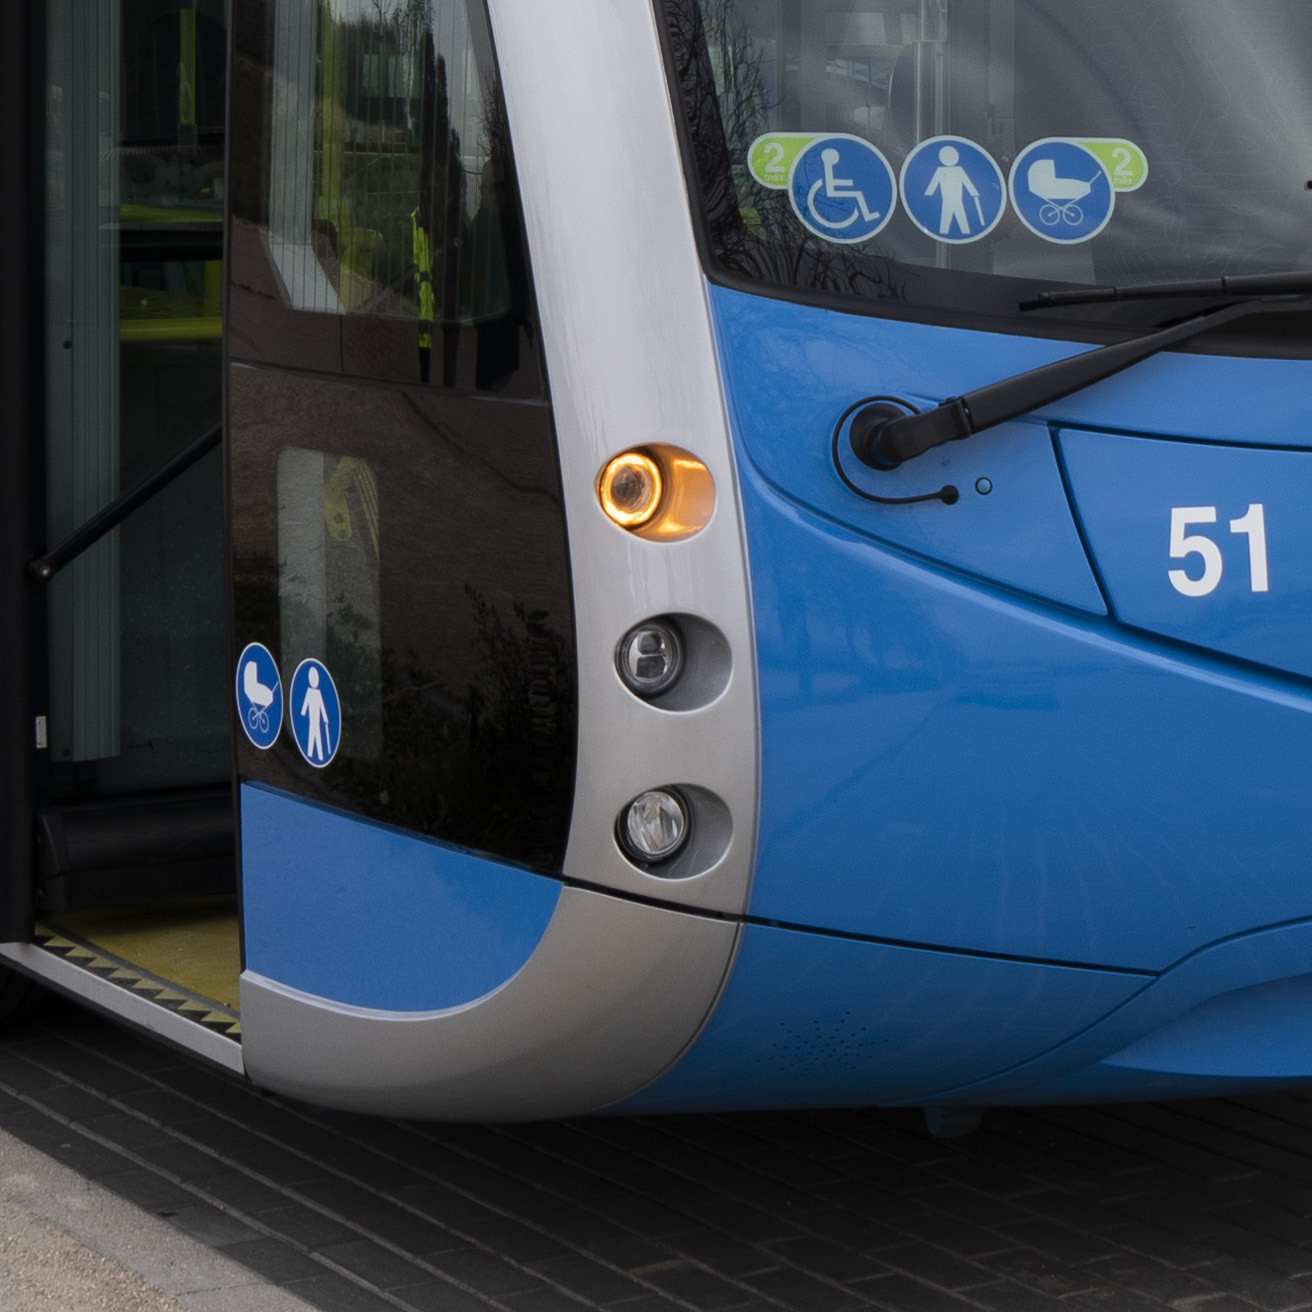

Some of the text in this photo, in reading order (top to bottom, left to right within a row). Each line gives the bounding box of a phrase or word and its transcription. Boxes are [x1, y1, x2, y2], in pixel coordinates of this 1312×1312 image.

[764, 142, 786, 173] 2
[1112, 147, 1134, 176] 2
[1167, 503, 1269, 597] 51
